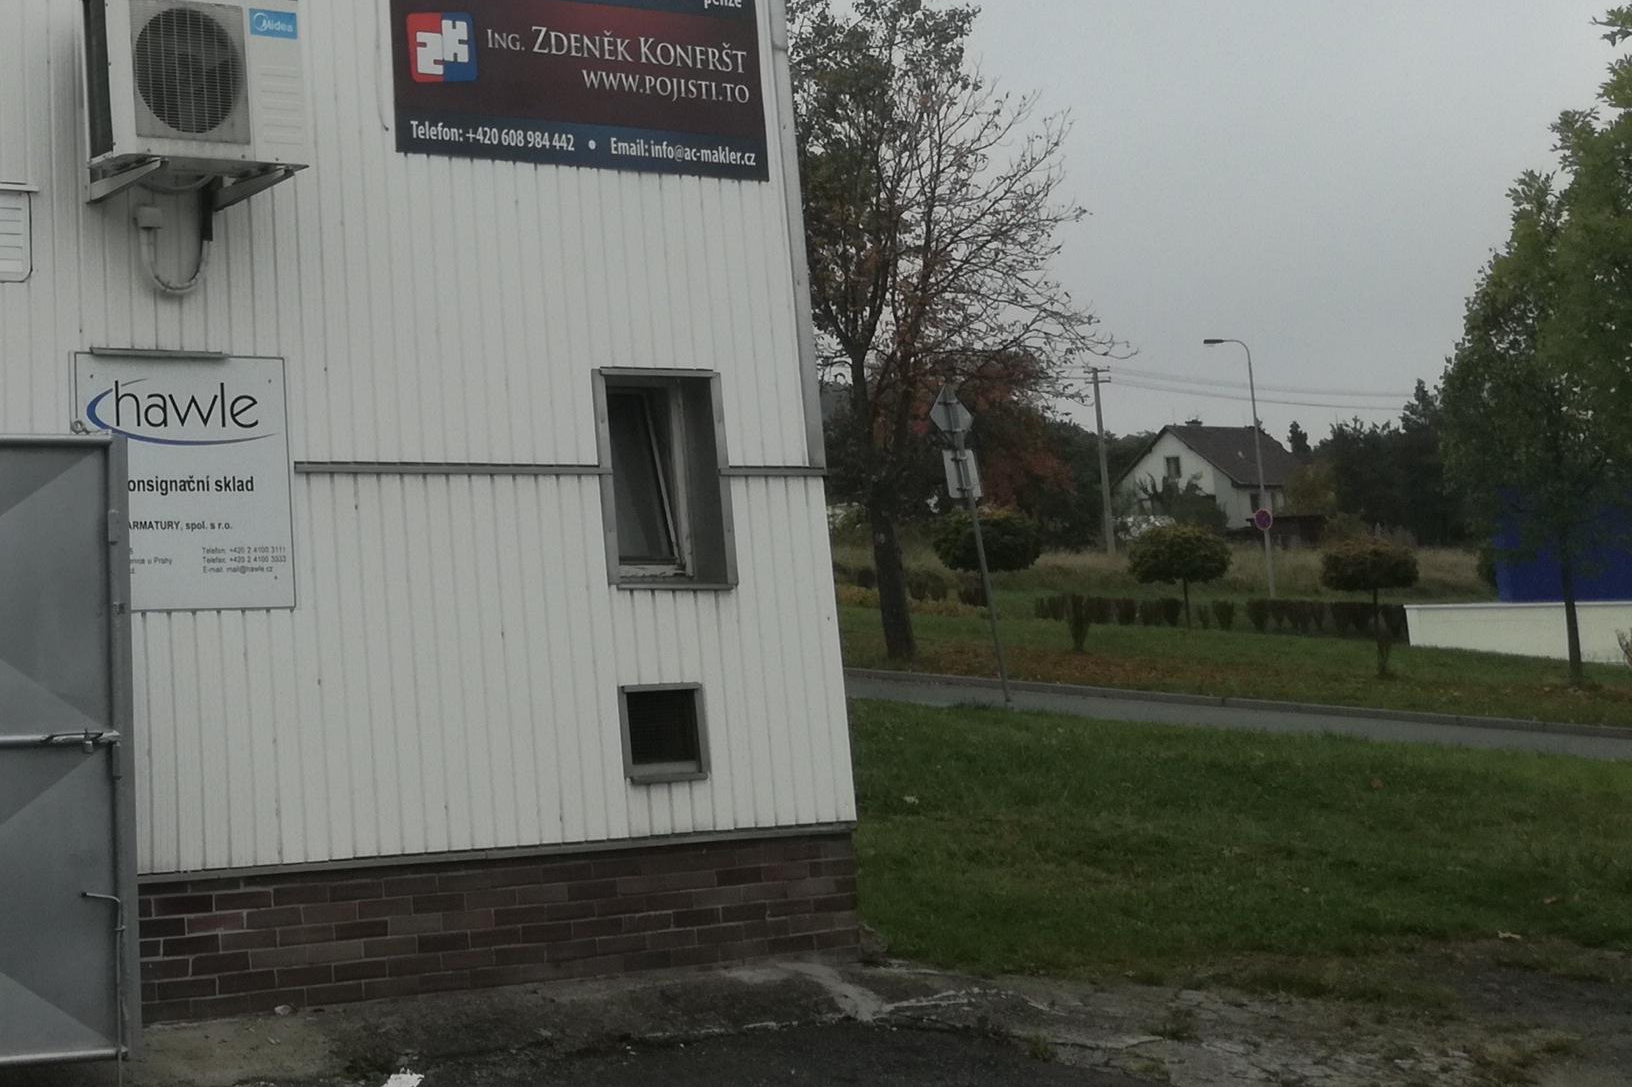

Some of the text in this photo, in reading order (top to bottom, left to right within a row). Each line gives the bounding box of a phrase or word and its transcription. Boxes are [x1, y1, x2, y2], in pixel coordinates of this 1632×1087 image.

[410, 120, 756, 167] Telefon: +420 608 984 442 Email: info@ac-makler.cz
[114, 380, 259, 429] hawle
[127, 475, 254, 496] onsignační sklad
[210, 522, 216, 530] s
